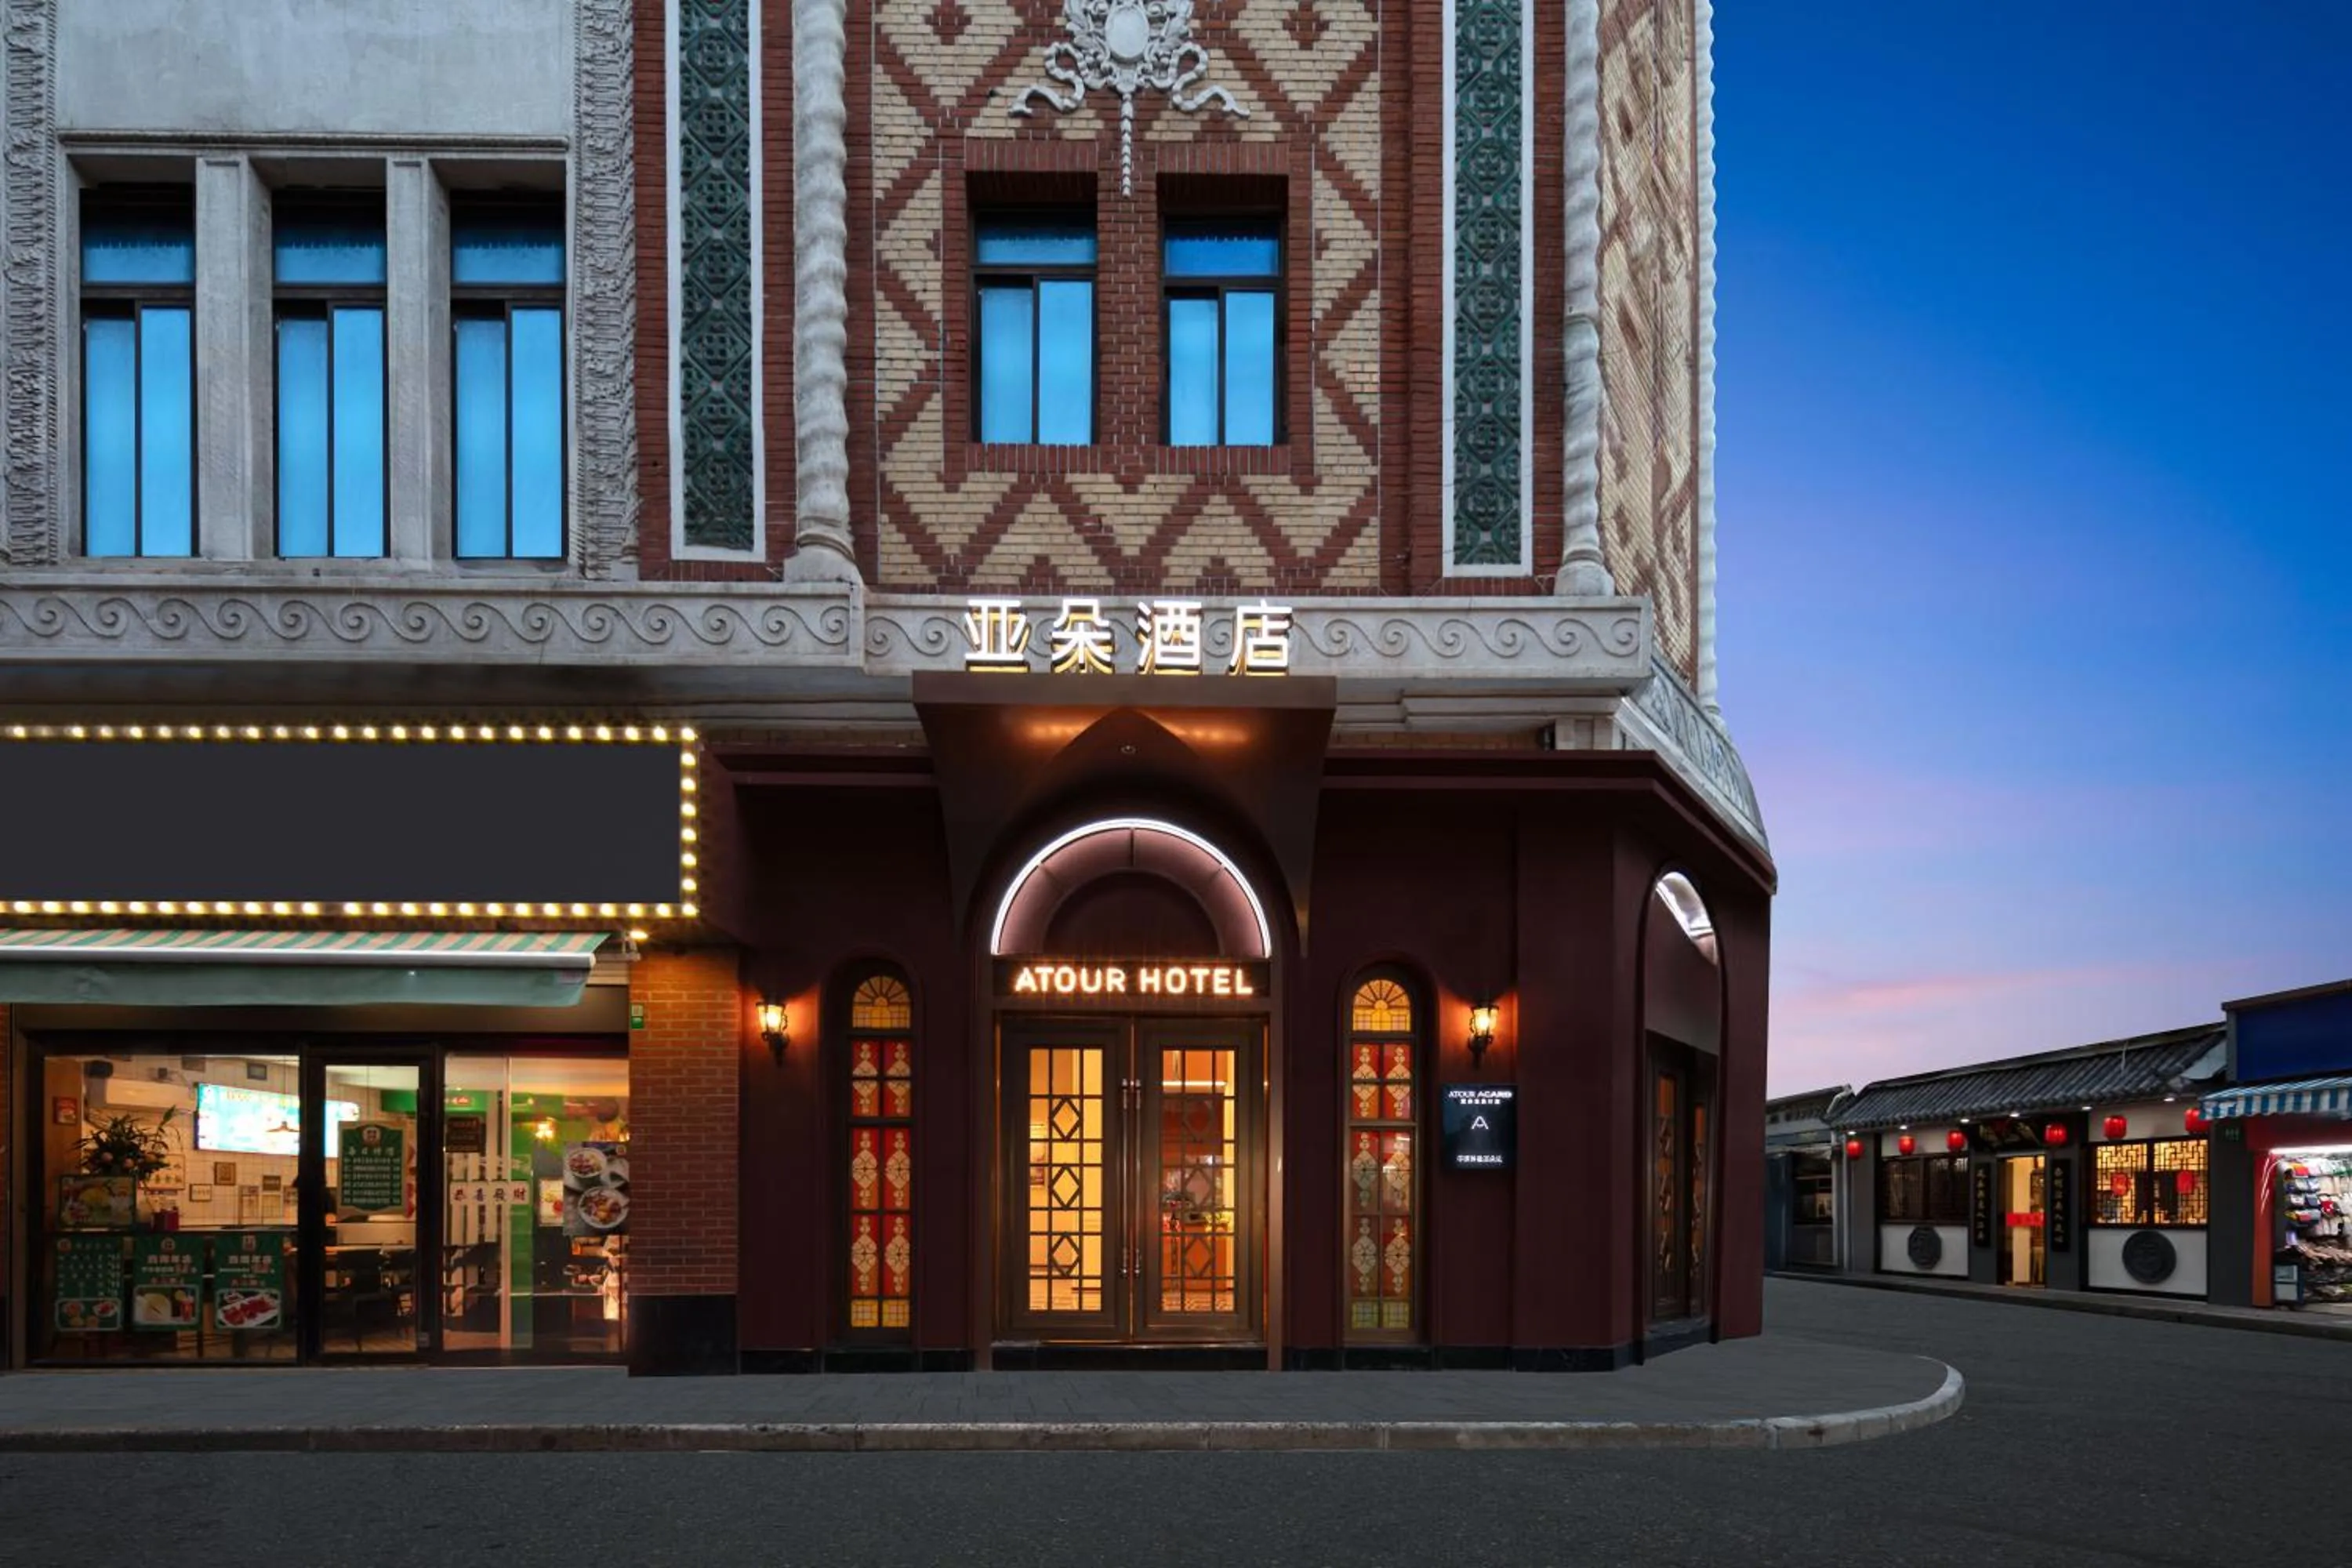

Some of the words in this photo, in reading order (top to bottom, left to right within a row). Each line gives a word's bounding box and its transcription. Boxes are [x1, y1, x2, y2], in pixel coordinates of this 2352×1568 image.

[964, 597, 1294, 673] 亚朵酒店
[1014, 965, 1127, 994] ATOUR
[1139, 967, 1254, 995] HOTEL
